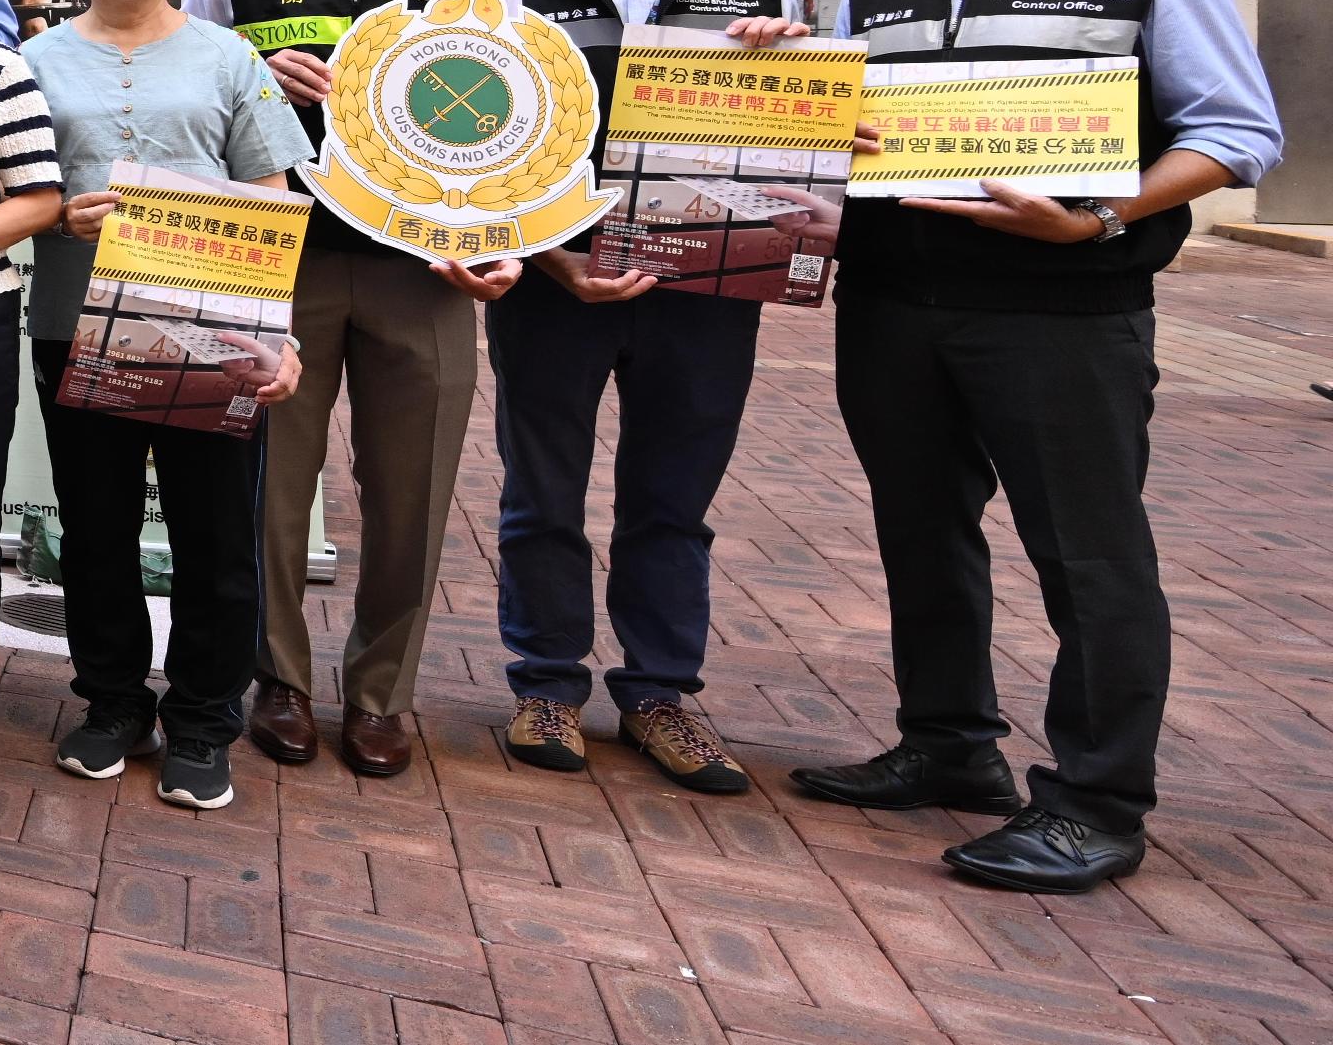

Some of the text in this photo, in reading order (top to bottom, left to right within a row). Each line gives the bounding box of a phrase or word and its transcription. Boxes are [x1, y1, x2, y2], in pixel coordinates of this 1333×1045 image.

[721, 6, 747, 14] Office
[728, 0, 759, 7] Alcohol
[1012, 0, 1104, 12] Control Office
[410, 40, 511, 69] HONG KONG
[626, 63, 853, 98] 嚴禁分發吸煙產品廣告
[633, 85, 838, 119] 最高罰款港幣五萬元
[391, 106, 528, 163] CUSTOMS AND EXCISE
[692, 145, 728, 171] 42
[684, 194, 721, 219] 43
[111, 202, 297, 250] 嚴禁分發吸煙產品廣告
[635, 213, 682, 225] 2961 8823
[118, 222, 284, 269] 最高罰款港幣五萬元
[399, 218, 510, 253] 香港海關
[660, 236, 707, 249] 2545 6182
[642, 243, 683, 255] 1833 183
[106, 349, 146, 364] 2961 8823
[107, 377, 142, 390] 1833 183
[123, 372, 164, 386] 2545 6182
